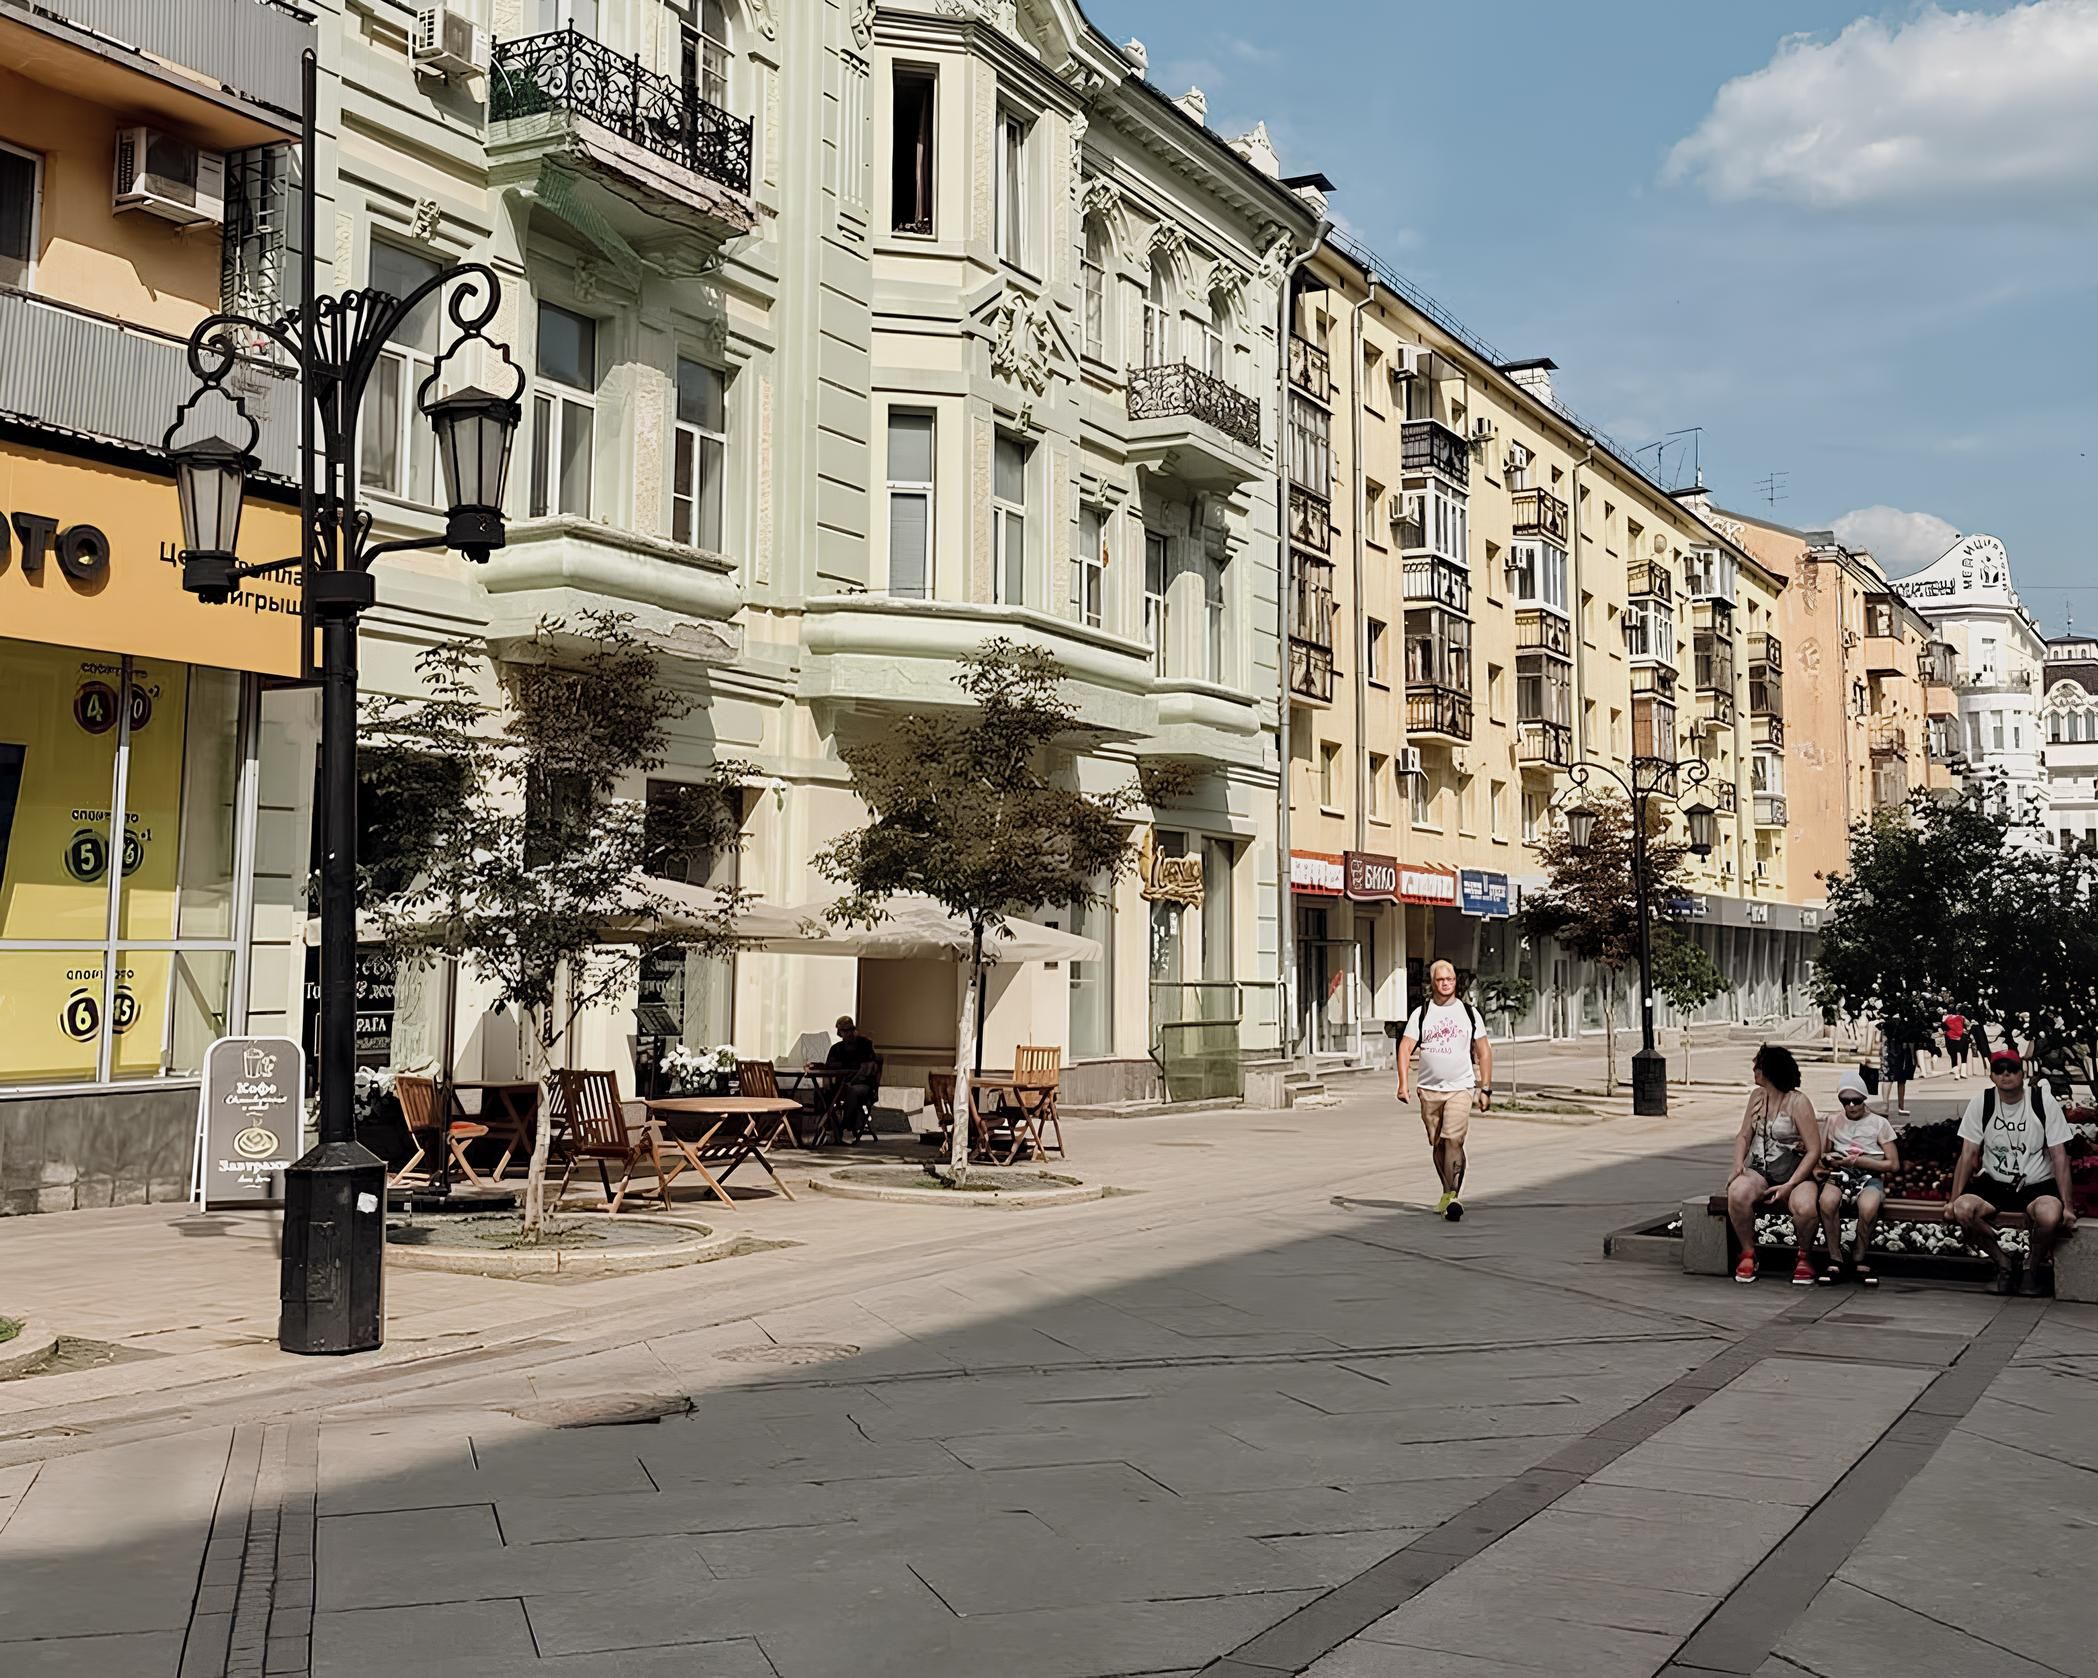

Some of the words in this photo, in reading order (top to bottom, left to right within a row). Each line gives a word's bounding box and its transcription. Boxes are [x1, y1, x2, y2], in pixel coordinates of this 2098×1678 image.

[0, 511, 110, 581] ТО
[80, 843, 95, 871] 5
[75, 1002, 92, 1031] 6
[1994, 1116, 2027, 1132] Dad
